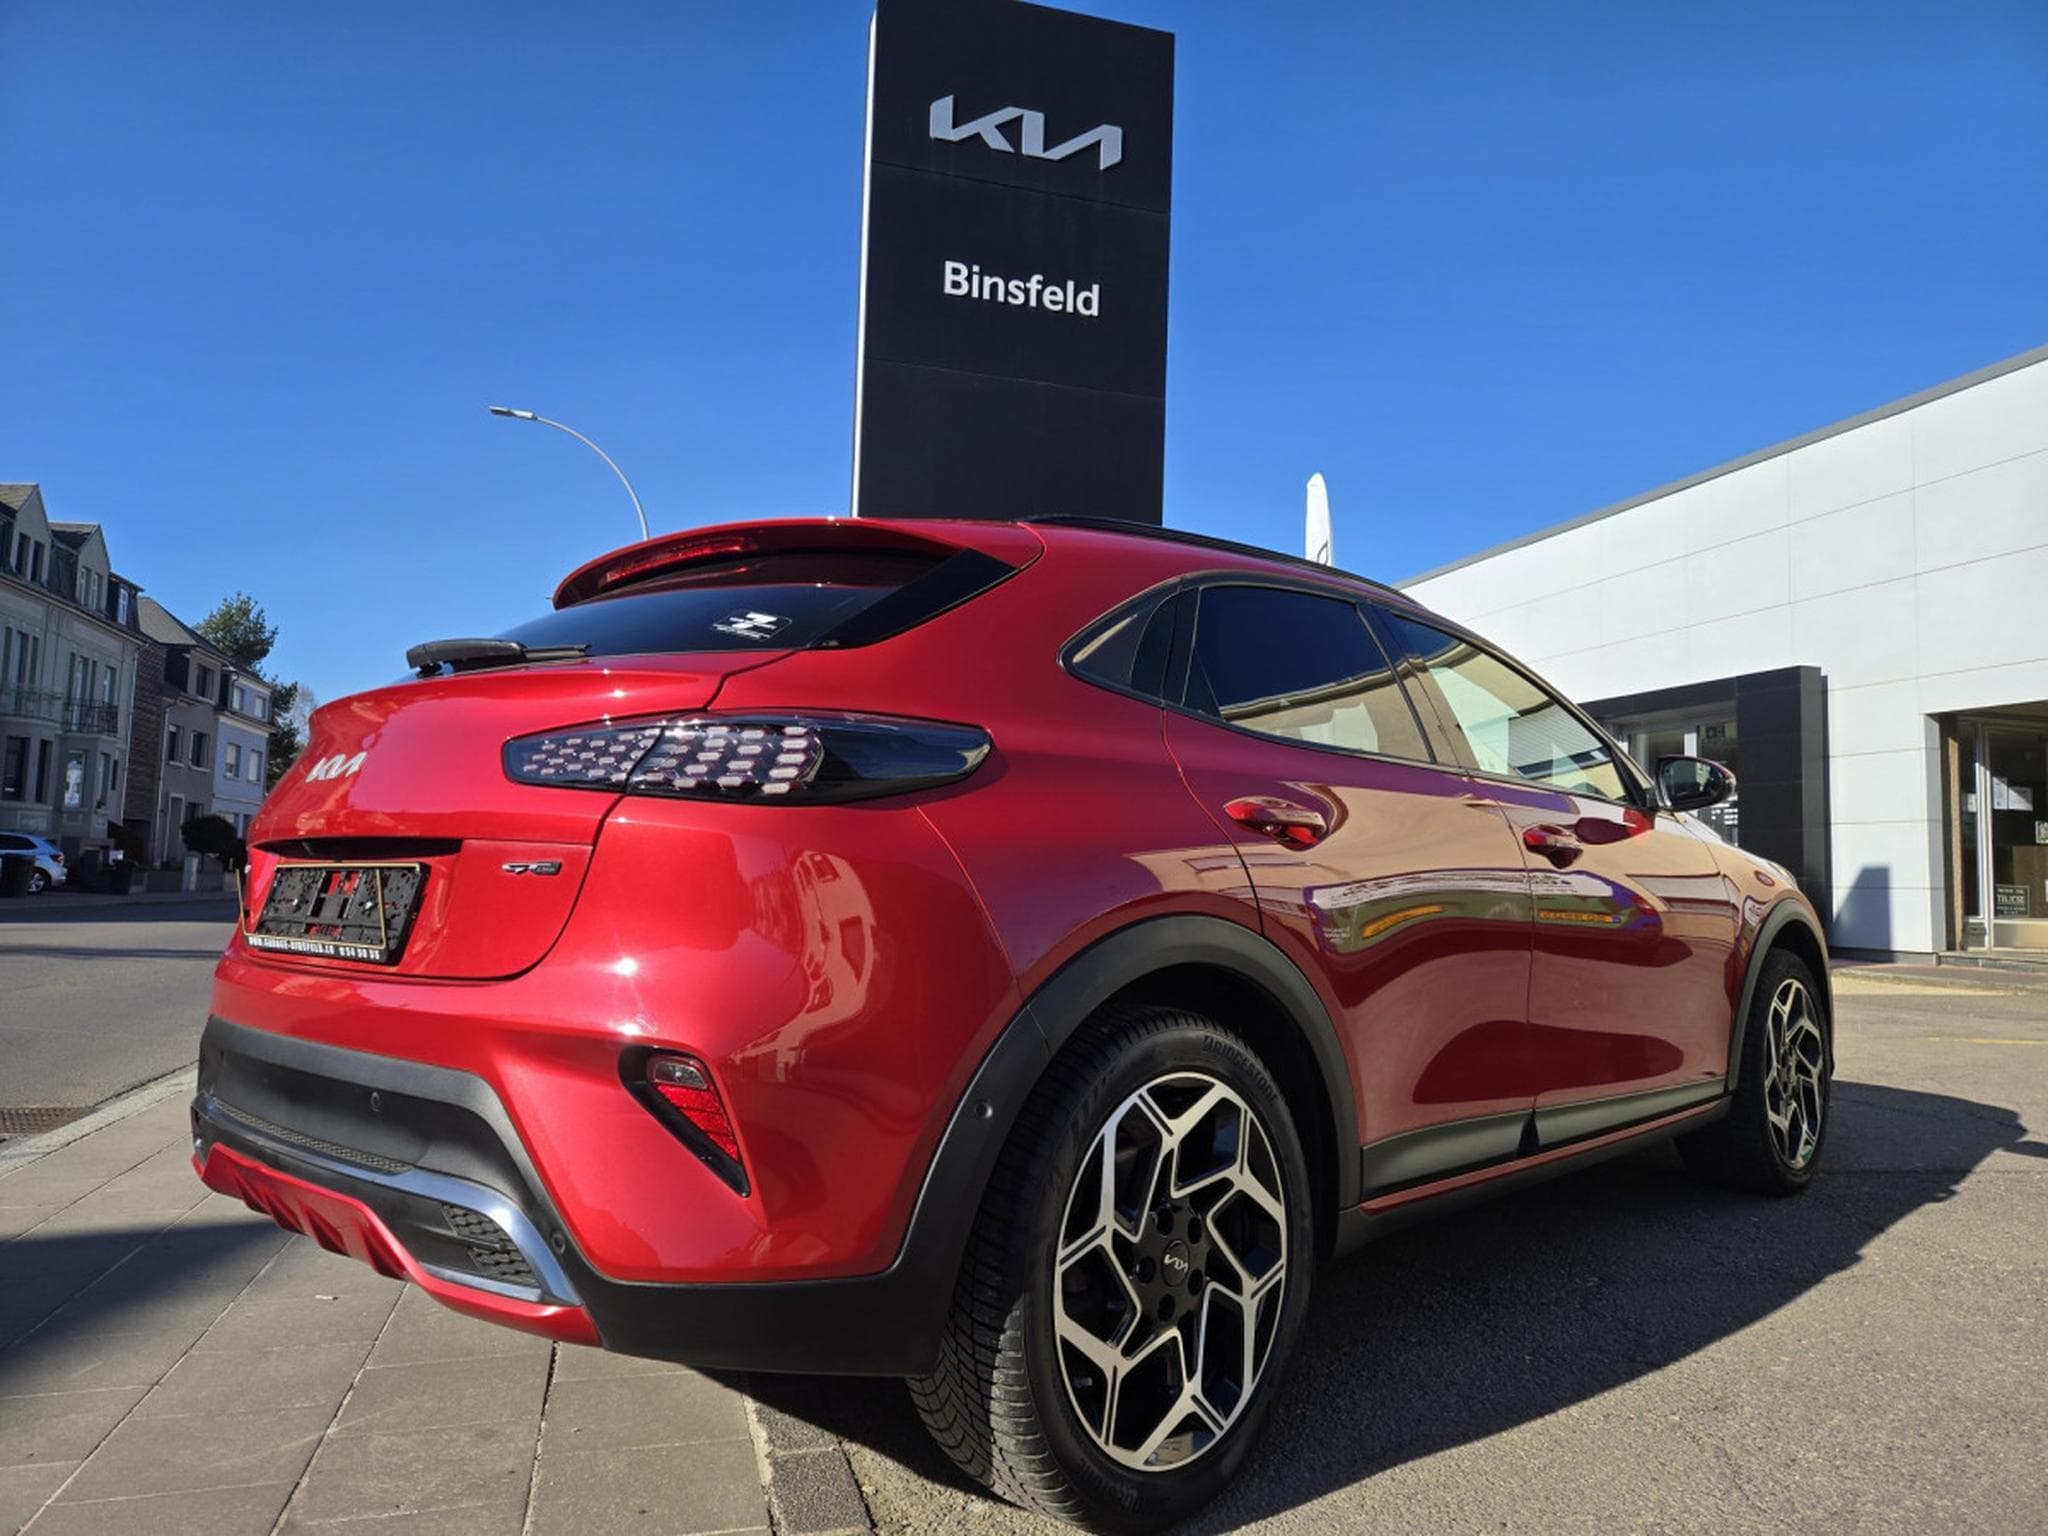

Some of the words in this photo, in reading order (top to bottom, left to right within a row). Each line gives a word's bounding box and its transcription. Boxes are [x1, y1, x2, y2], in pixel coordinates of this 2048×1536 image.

[929, 94, 1123, 171] KIA
[943, 260, 1100, 317] Binsfeld
[305, 751, 368, 783] KIA
